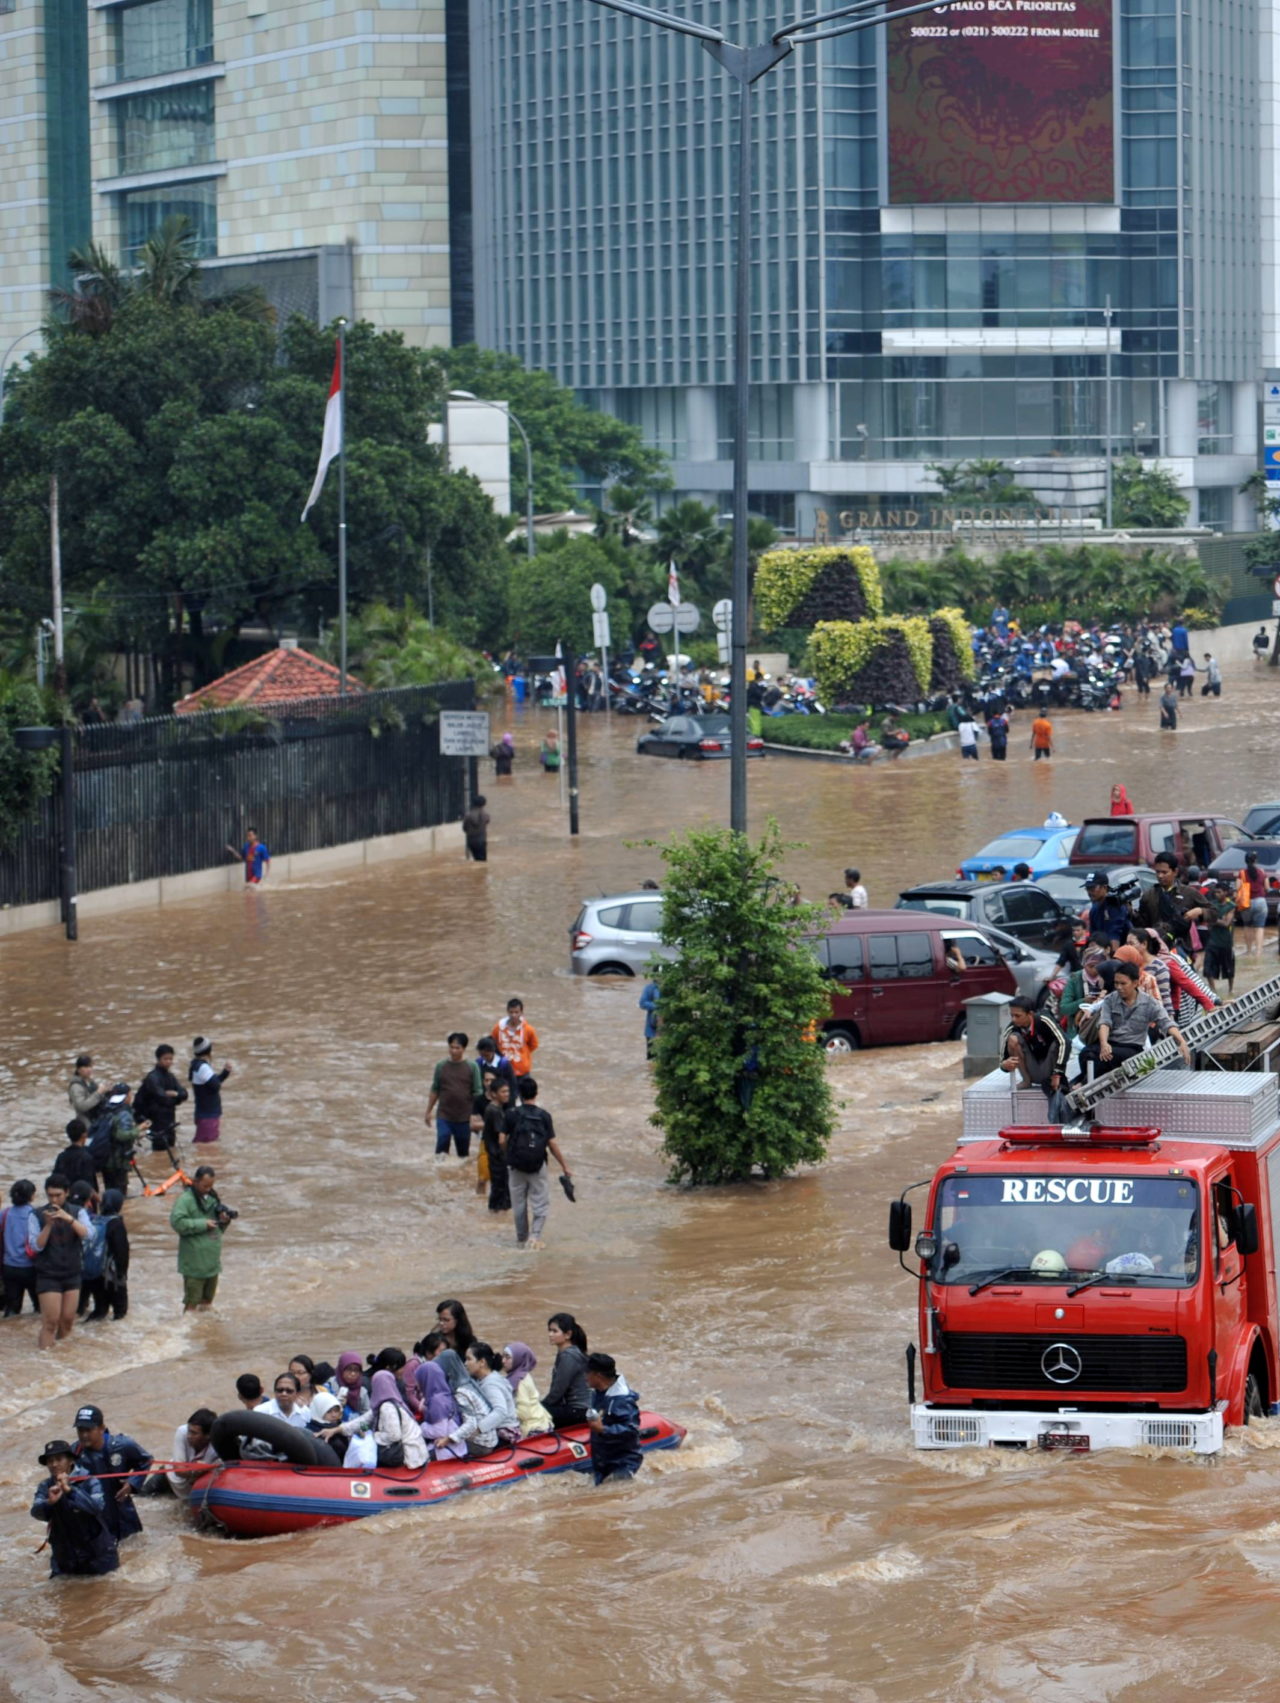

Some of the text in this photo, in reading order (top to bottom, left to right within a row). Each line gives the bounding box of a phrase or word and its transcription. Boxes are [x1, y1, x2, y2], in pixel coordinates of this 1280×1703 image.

[988, 0, 1014, 11] BCA
[1016, 0, 1077, 12] PRIORITAS
[911, 26, 1100, 38] 500222 or (021) 500222 FROM MOBILE
[839, 508, 1076, 528] GRAND INDONESIA
[1000, 1179, 1134, 1204] RESCUE
